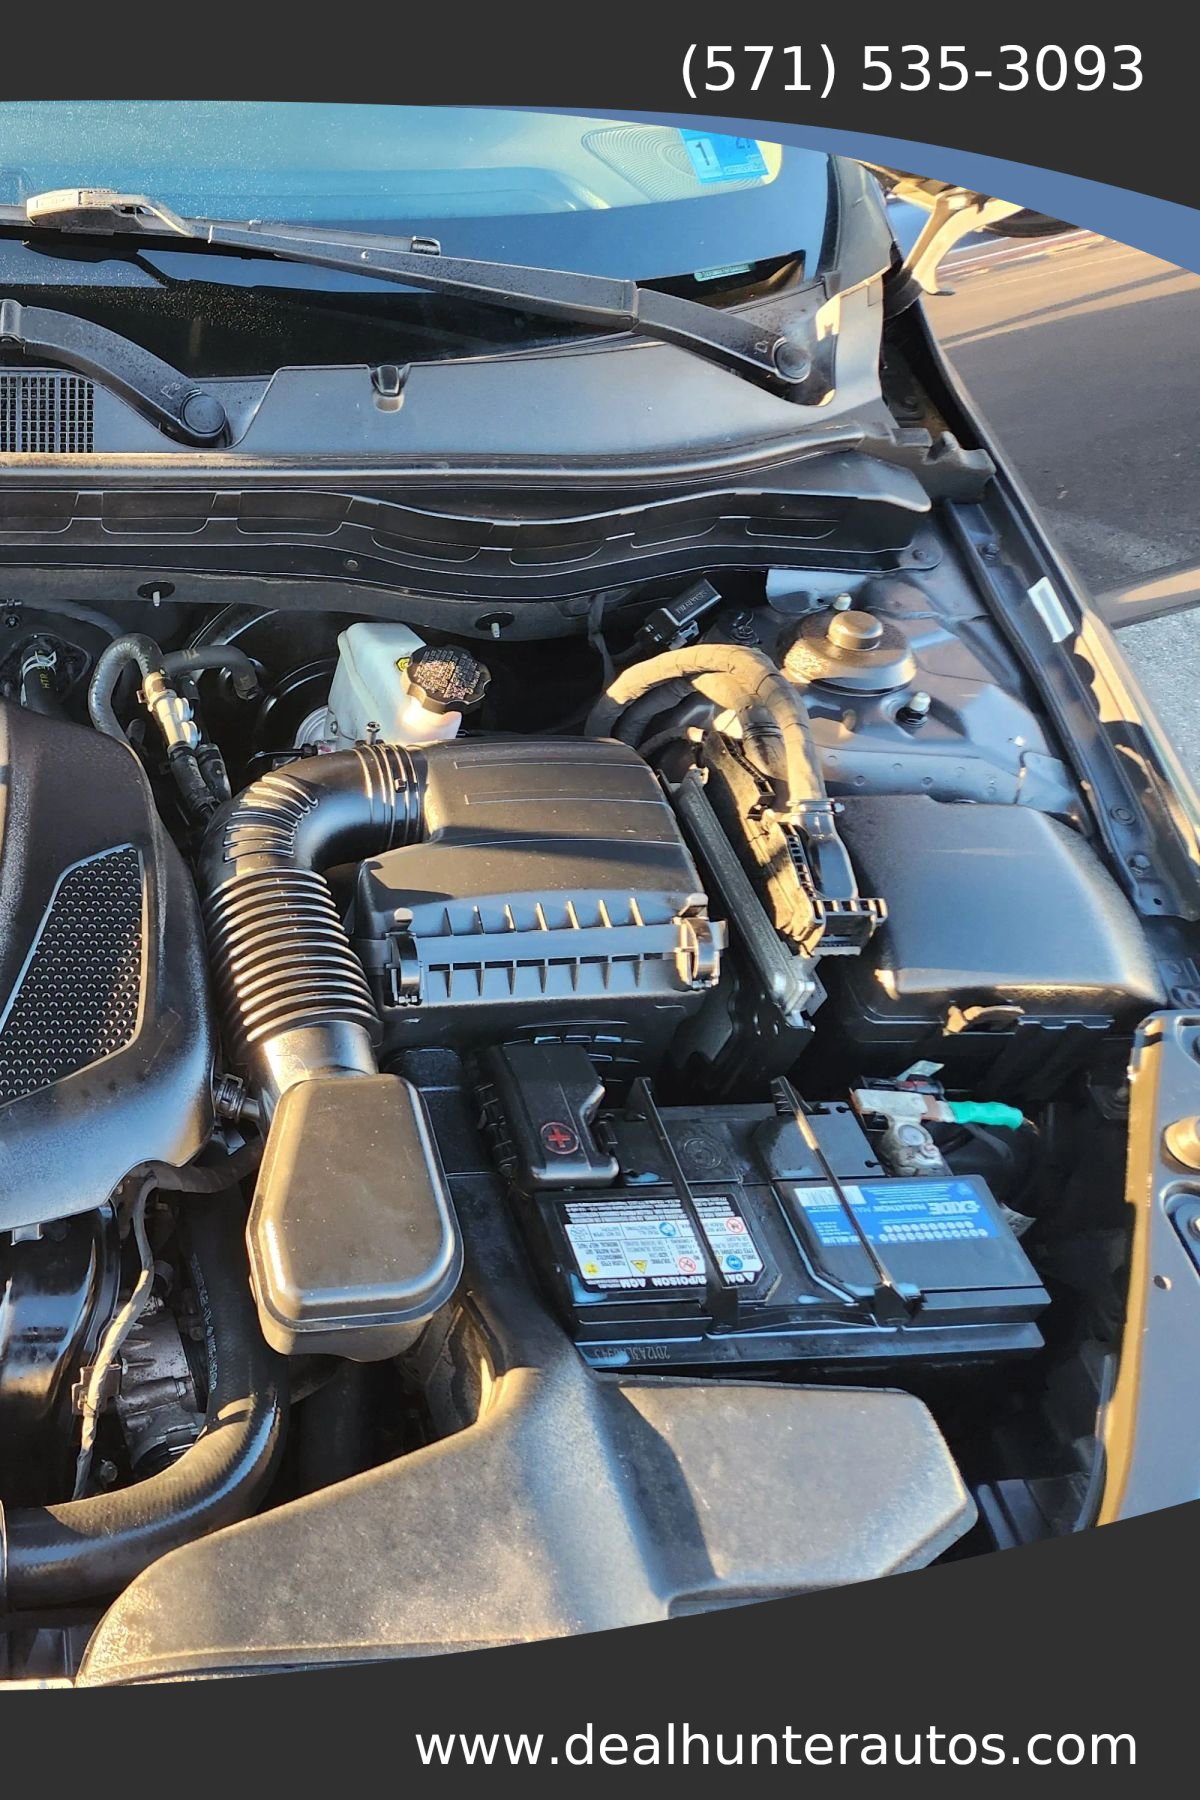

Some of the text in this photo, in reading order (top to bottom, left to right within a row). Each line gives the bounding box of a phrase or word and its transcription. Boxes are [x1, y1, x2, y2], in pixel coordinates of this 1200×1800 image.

[695, 141, 710, 166] 1
[927, 1200, 980, 1216] EXIDE
[620, 1278, 646, 1288] AGM
